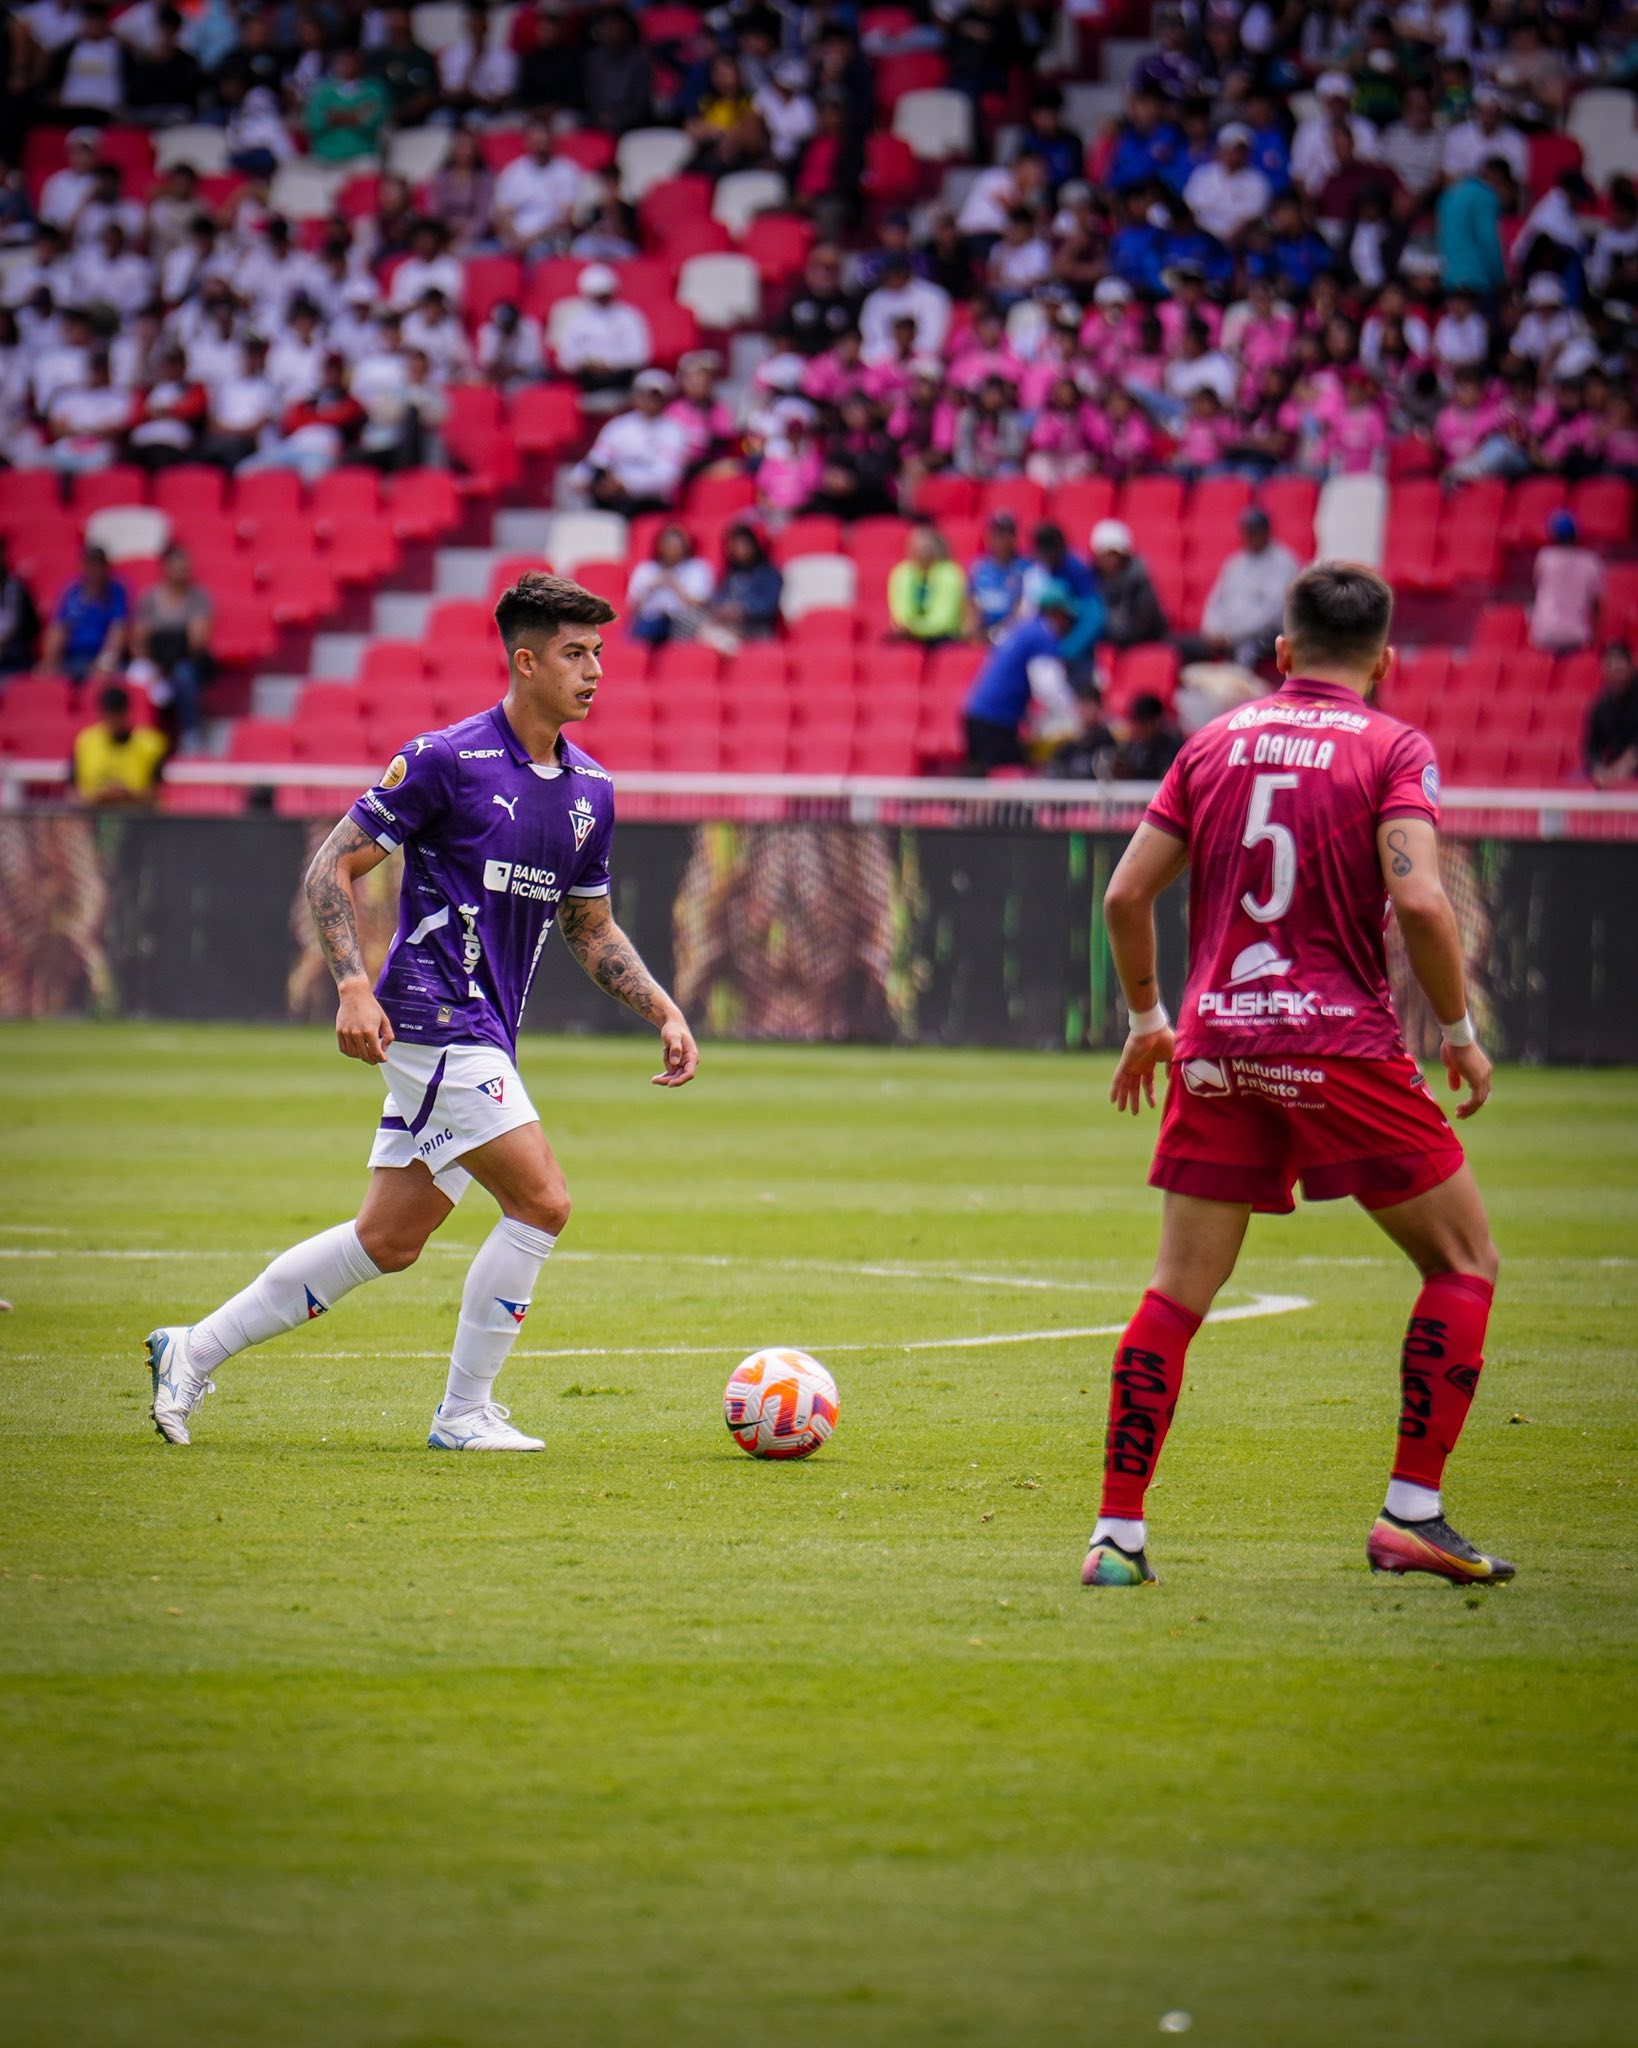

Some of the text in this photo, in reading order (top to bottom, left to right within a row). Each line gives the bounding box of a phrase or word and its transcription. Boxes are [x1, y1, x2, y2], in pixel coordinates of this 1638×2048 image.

[1319, 709, 1370, 729] WASI
[459, 749, 504, 759] CHERY
[1254, 733, 1336, 770] DAVILA
[574, 766, 612, 782] CHERY
[1241, 773, 1299, 923] 5
[513, 864, 556, 886] BANCO
[1198, 990, 1320, 1017] PUSHAK
[1231, 1059, 1325, 1083] Mutualista
[1237, 1075, 1298, 1097] Ambato
